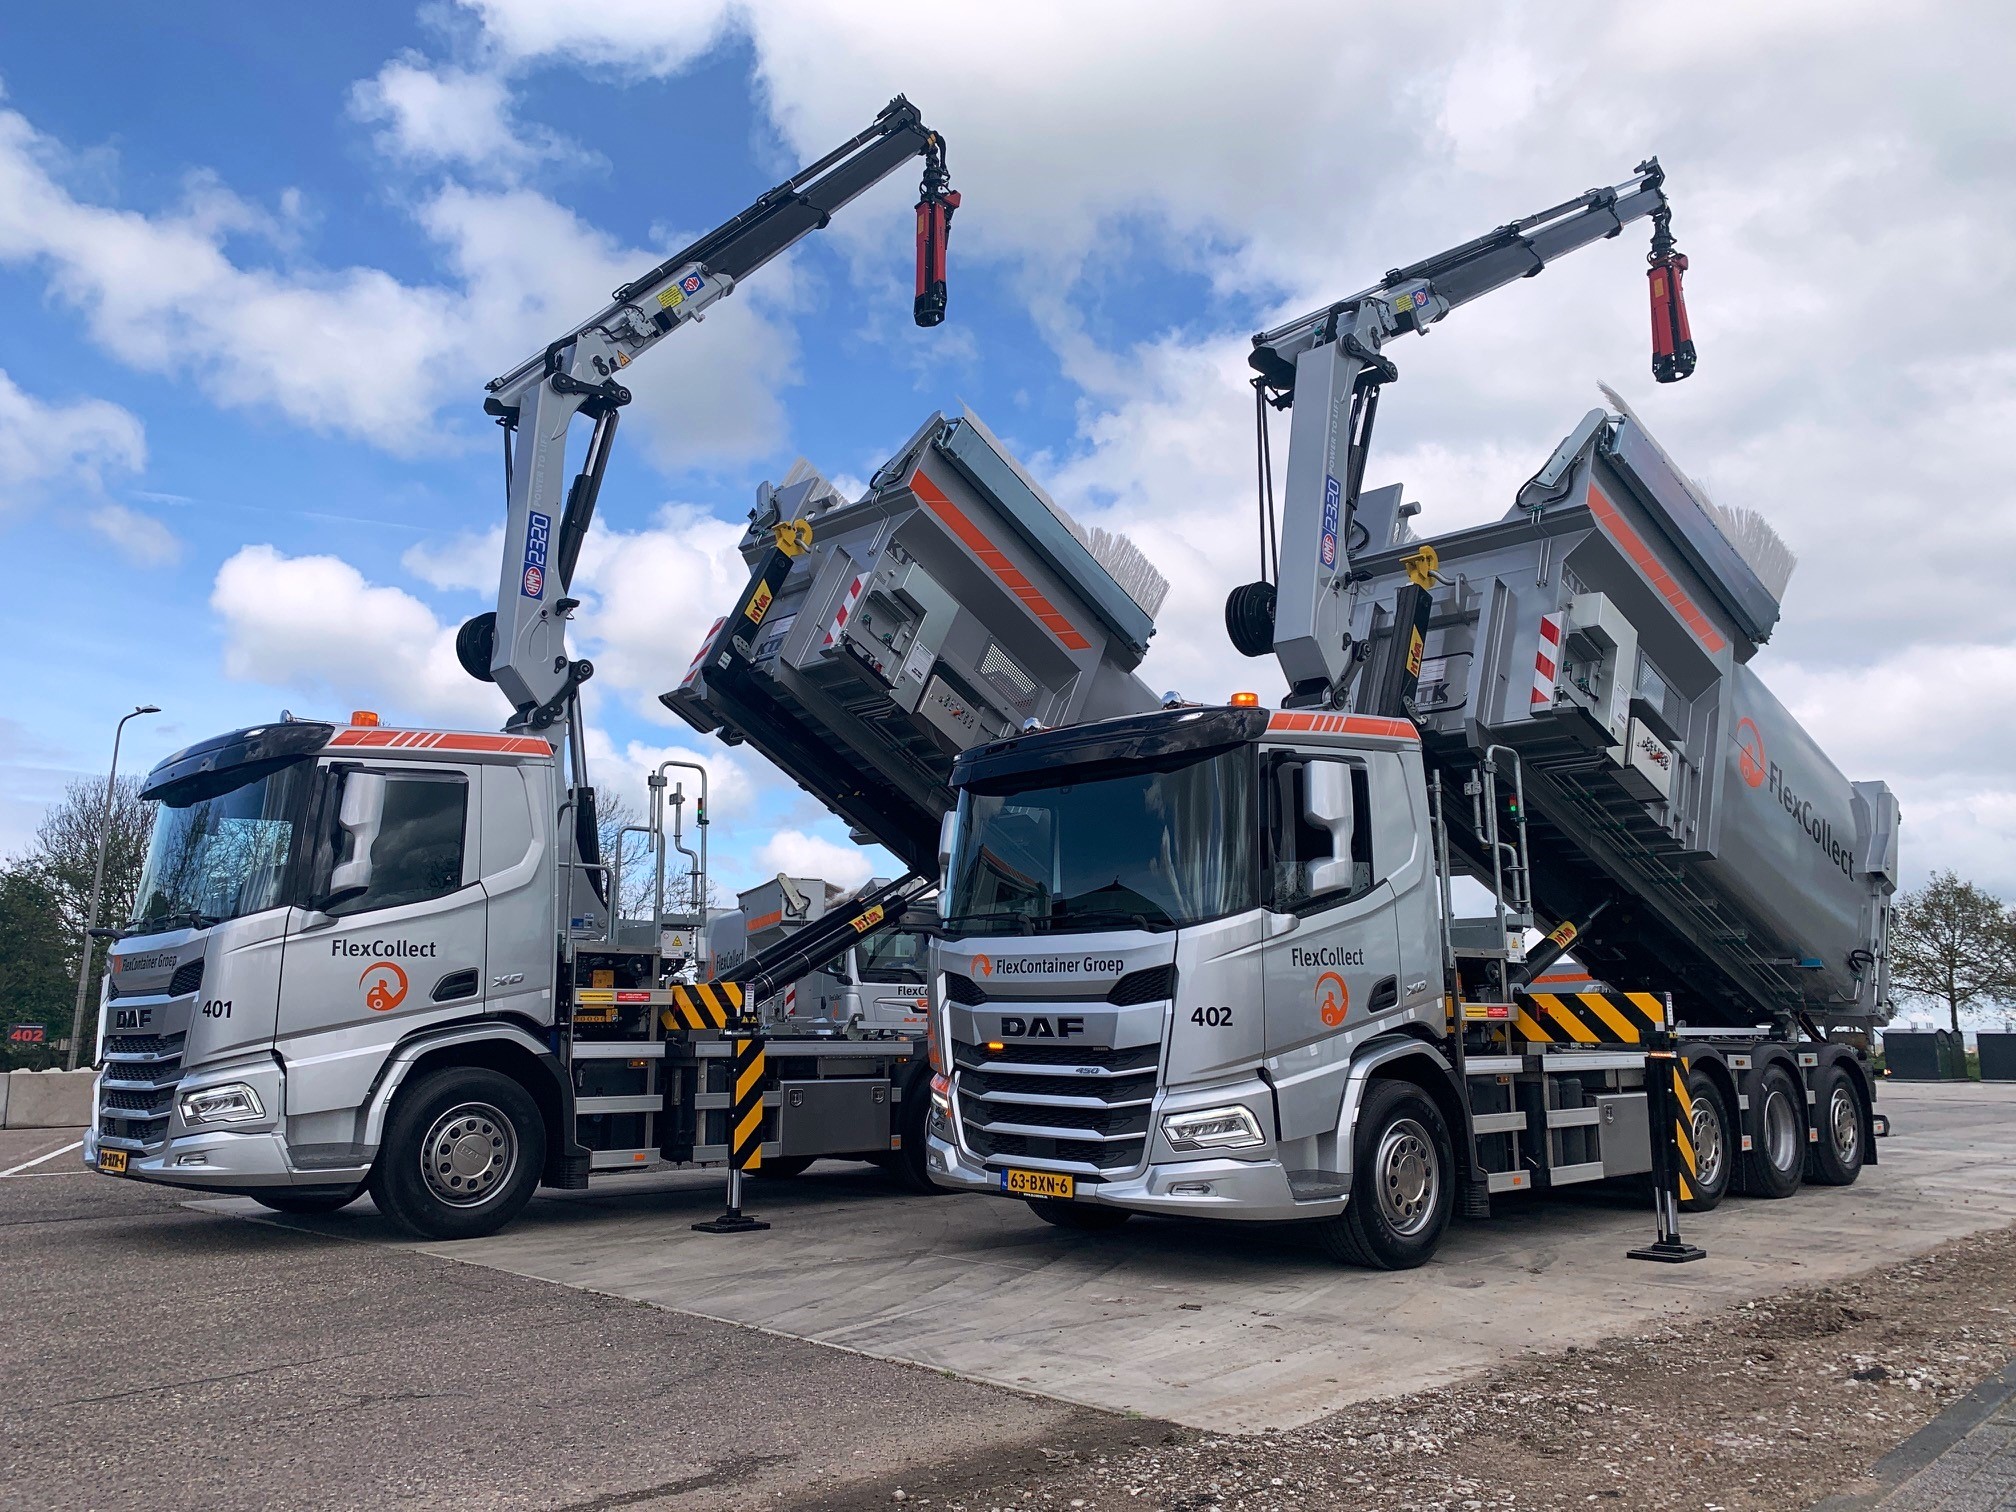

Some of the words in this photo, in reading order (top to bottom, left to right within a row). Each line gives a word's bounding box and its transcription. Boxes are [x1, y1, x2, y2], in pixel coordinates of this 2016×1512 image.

[1332, 422, 1339, 437] TO
[540, 434, 549, 451] LIFT
[538, 454, 547, 468] TO
[1329, 438, 1338, 475] POWER
[534, 467, 546, 507] POWER
[1325, 478, 1339, 533] 2320
[528, 514, 548, 566] 2320
[1322, 537, 1334, 563] HMF
[526, 569, 542, 595] HMF
[750, 593, 771, 623] HYVA
[1410, 642, 1422, 676] HYVA
[1769, 760, 1854, 882] FlexCollect
[854, 911, 882, 930] HYVA
[331, 939, 436, 957] FlexCollect
[1292, 947, 1364, 967] FlexCollect
[122, 955, 158, 972] FlexContainer
[157, 953, 178, 970] Groep
[996, 957, 1080, 974] FlexContainer
[1083, 956, 1124, 975] Groep
[492, 972, 525, 988] XD
[1405, 980, 1427, 997] XD
[116, 1009, 152, 1029] DAF
[202, 1000, 232, 1018] 401
[1190, 1006, 1234, 1027] 402
[11, 1029, 43, 1042] 402
[1001, 1017, 1084, 1039] DAF
[1075, 1067, 1100, 1075] 450
[1010, 1173, 1068, 1194] 63-BXN-6
